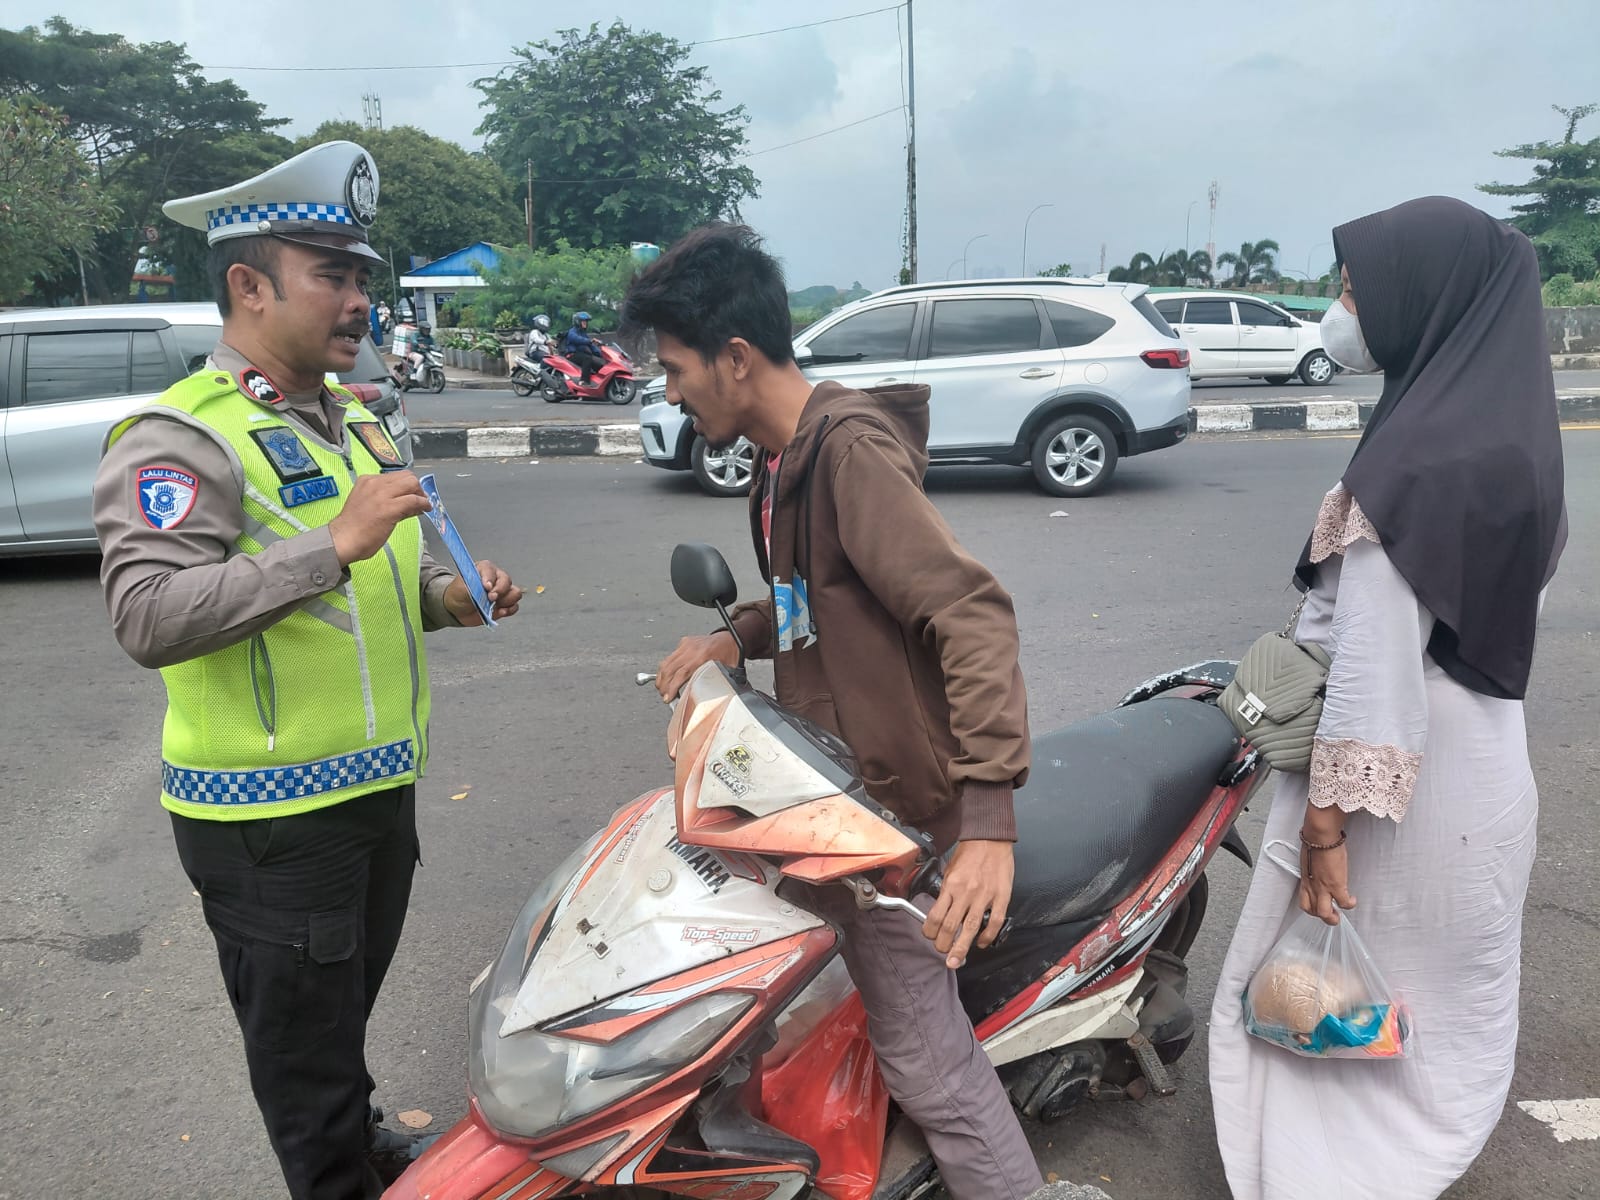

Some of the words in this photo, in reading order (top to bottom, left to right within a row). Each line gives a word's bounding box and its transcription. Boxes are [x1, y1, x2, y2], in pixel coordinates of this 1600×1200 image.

[142, 469, 163, 478] LALU
[165, 470, 194, 485] LINTAS
[292, 479, 333, 503] ANDI
[685, 927, 757, 943] Top-Speed
[1087, 964, 1116, 988] YAMAHA
